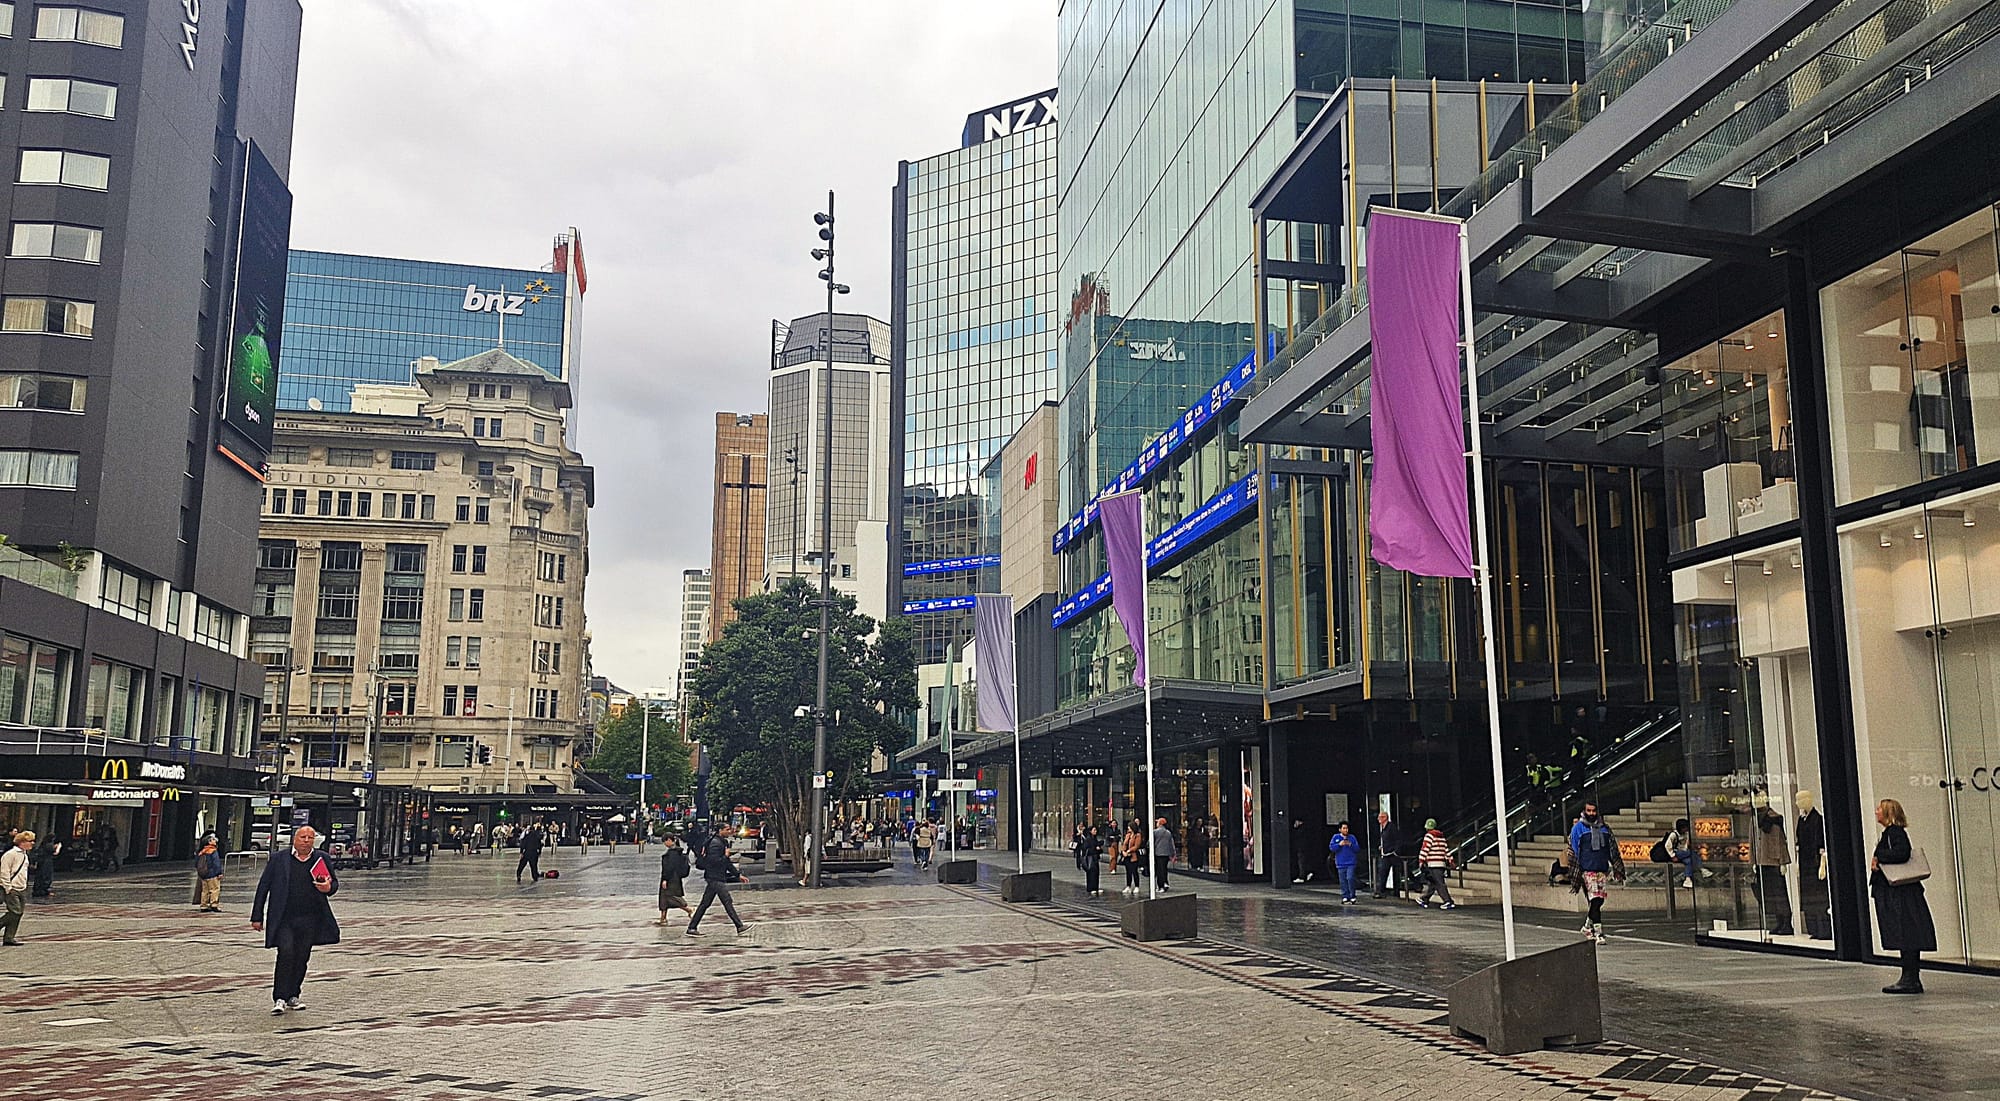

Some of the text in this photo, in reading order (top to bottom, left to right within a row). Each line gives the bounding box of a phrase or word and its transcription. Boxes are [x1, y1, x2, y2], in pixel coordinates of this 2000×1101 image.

[984, 94, 1058, 141] NZX
[463, 284, 526, 315] bnz
[245, 401, 260, 424] dyson
[265, 472, 386, 487] BUILDING
[141, 761, 186, 780] McDonald's
[1061, 768, 1104, 776] COACH
[92, 789, 160, 799] McDonald's
